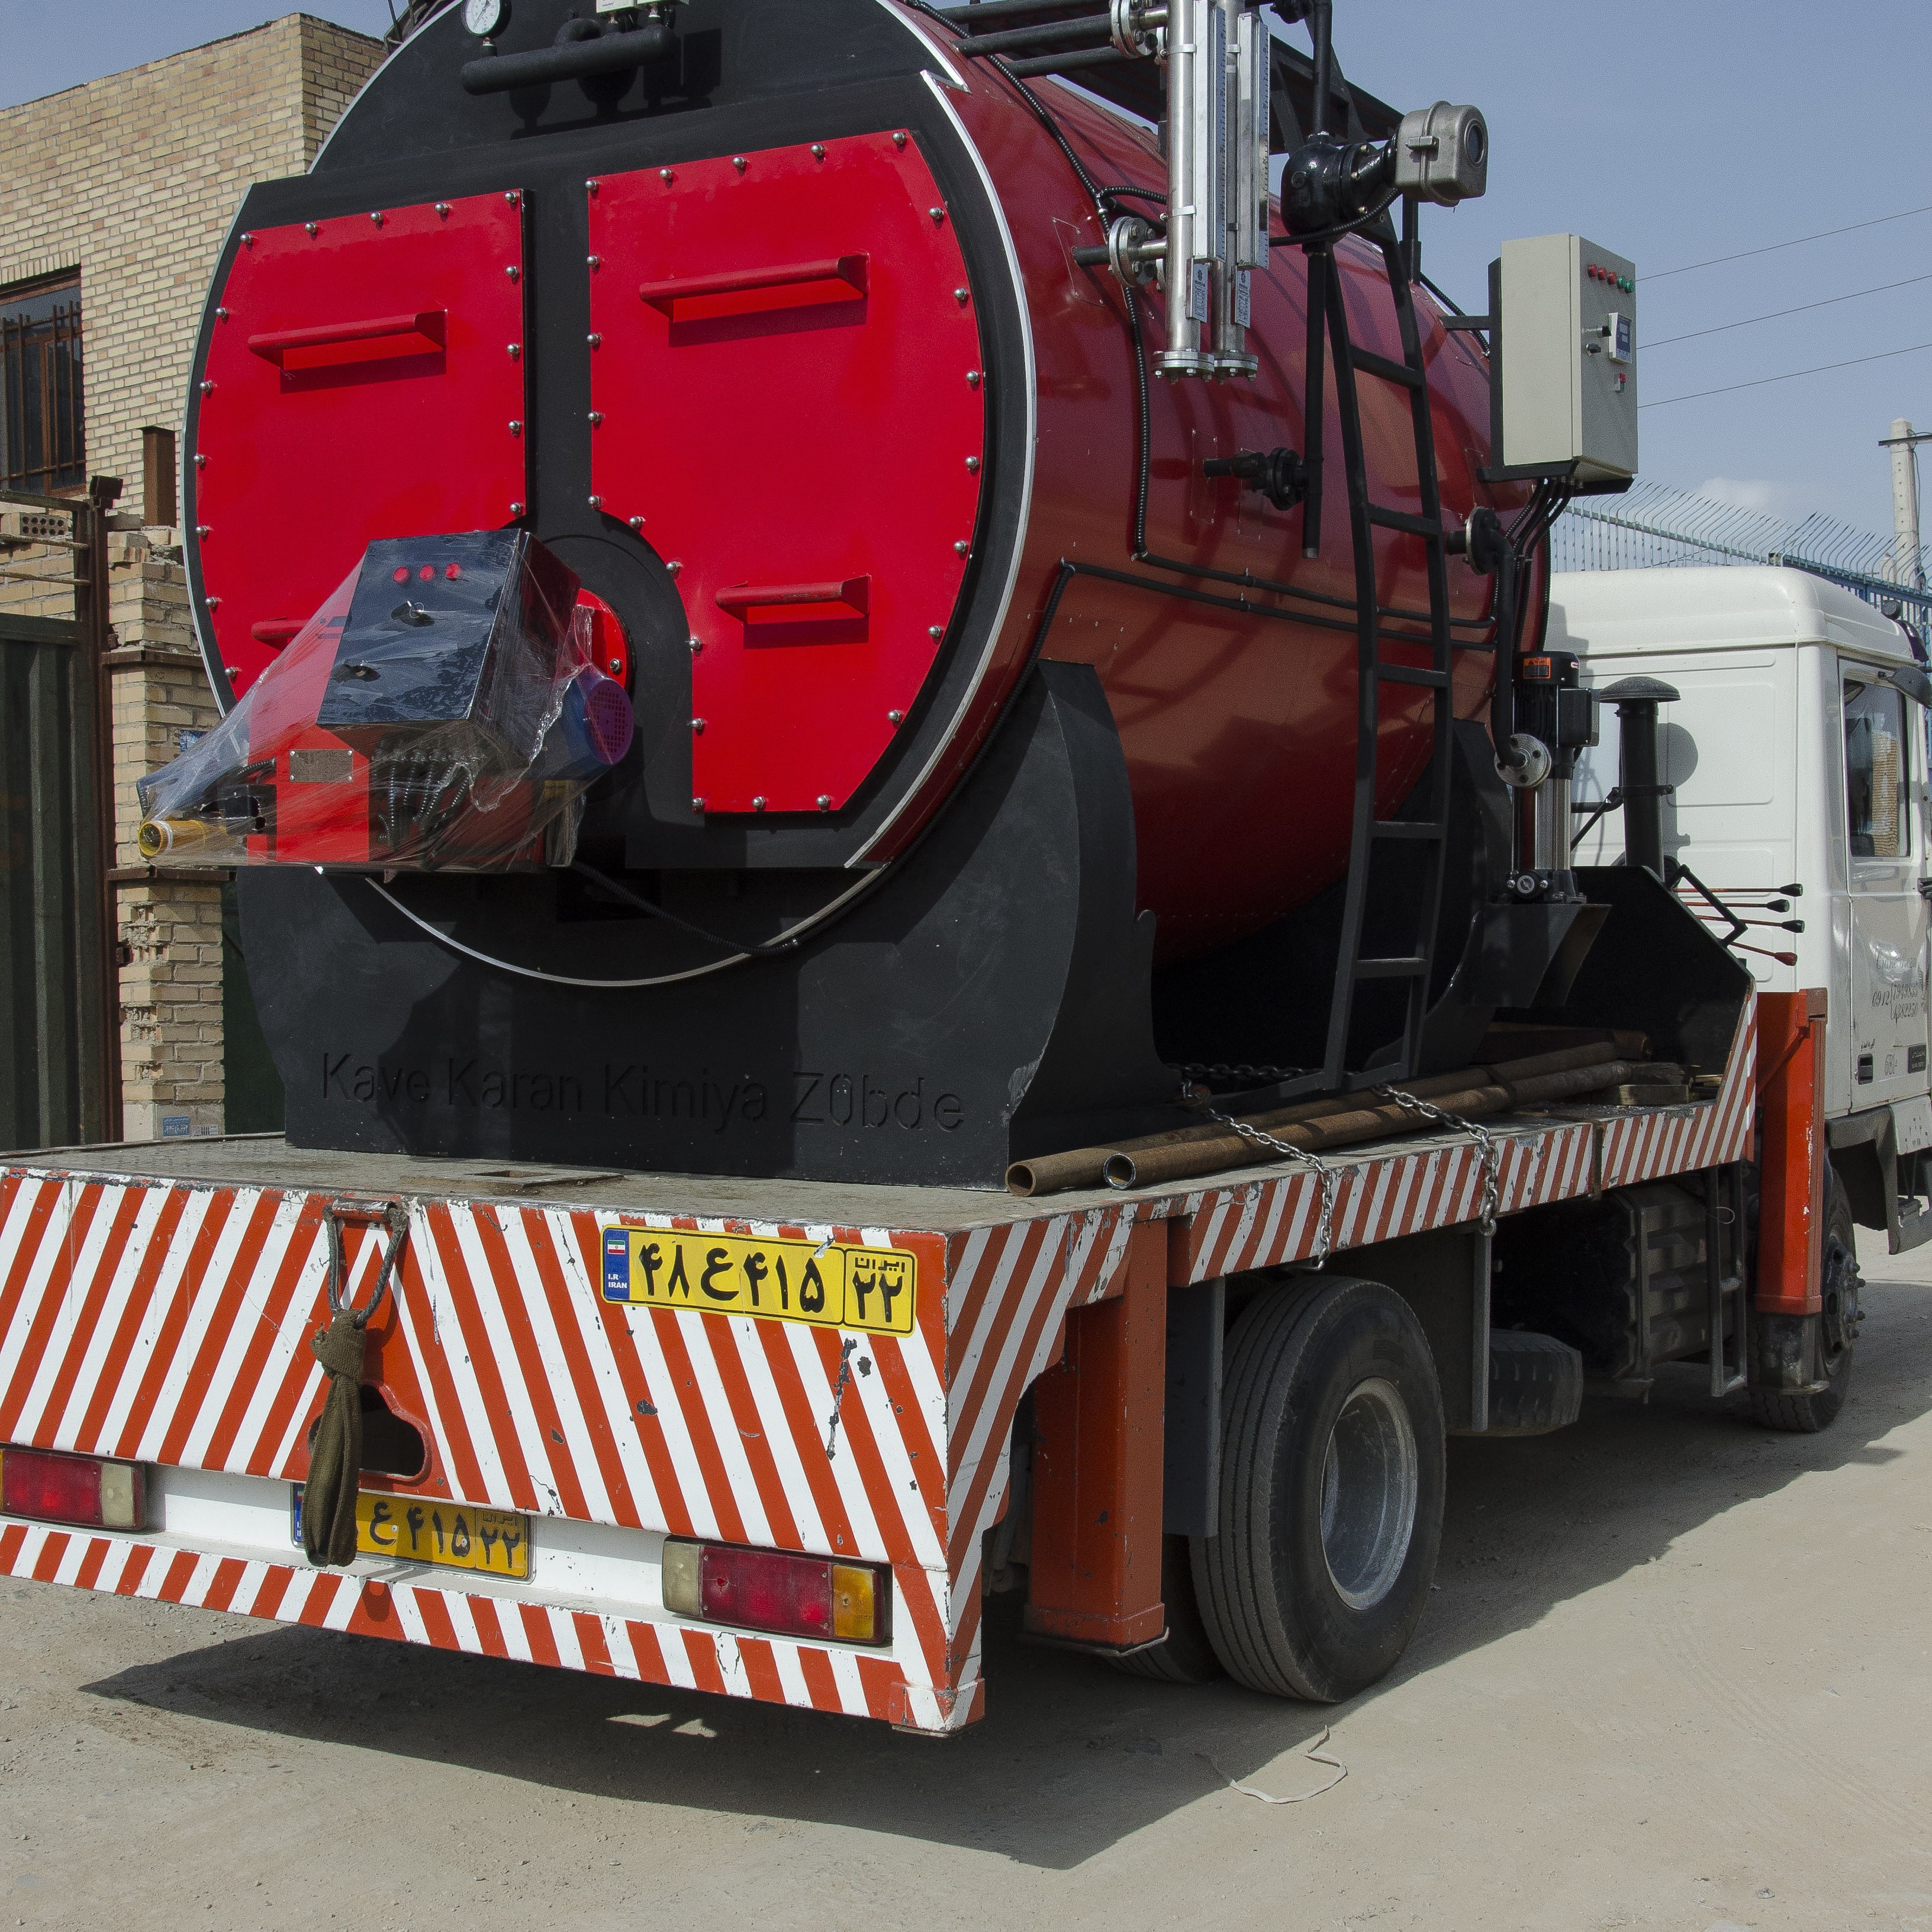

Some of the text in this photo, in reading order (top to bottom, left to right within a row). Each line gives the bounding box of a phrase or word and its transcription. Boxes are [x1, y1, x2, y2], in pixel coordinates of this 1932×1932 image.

[1872, 991, 1889, 1007] 0912
[323, 1052, 430, 1103] Kave
[447, 1057, 583, 1112] Karan
[604, 1064, 769, 1135] Kimiya
[855, 1257, 906, 1273] ایران
[852, 1270, 903, 1324] ۲۲
